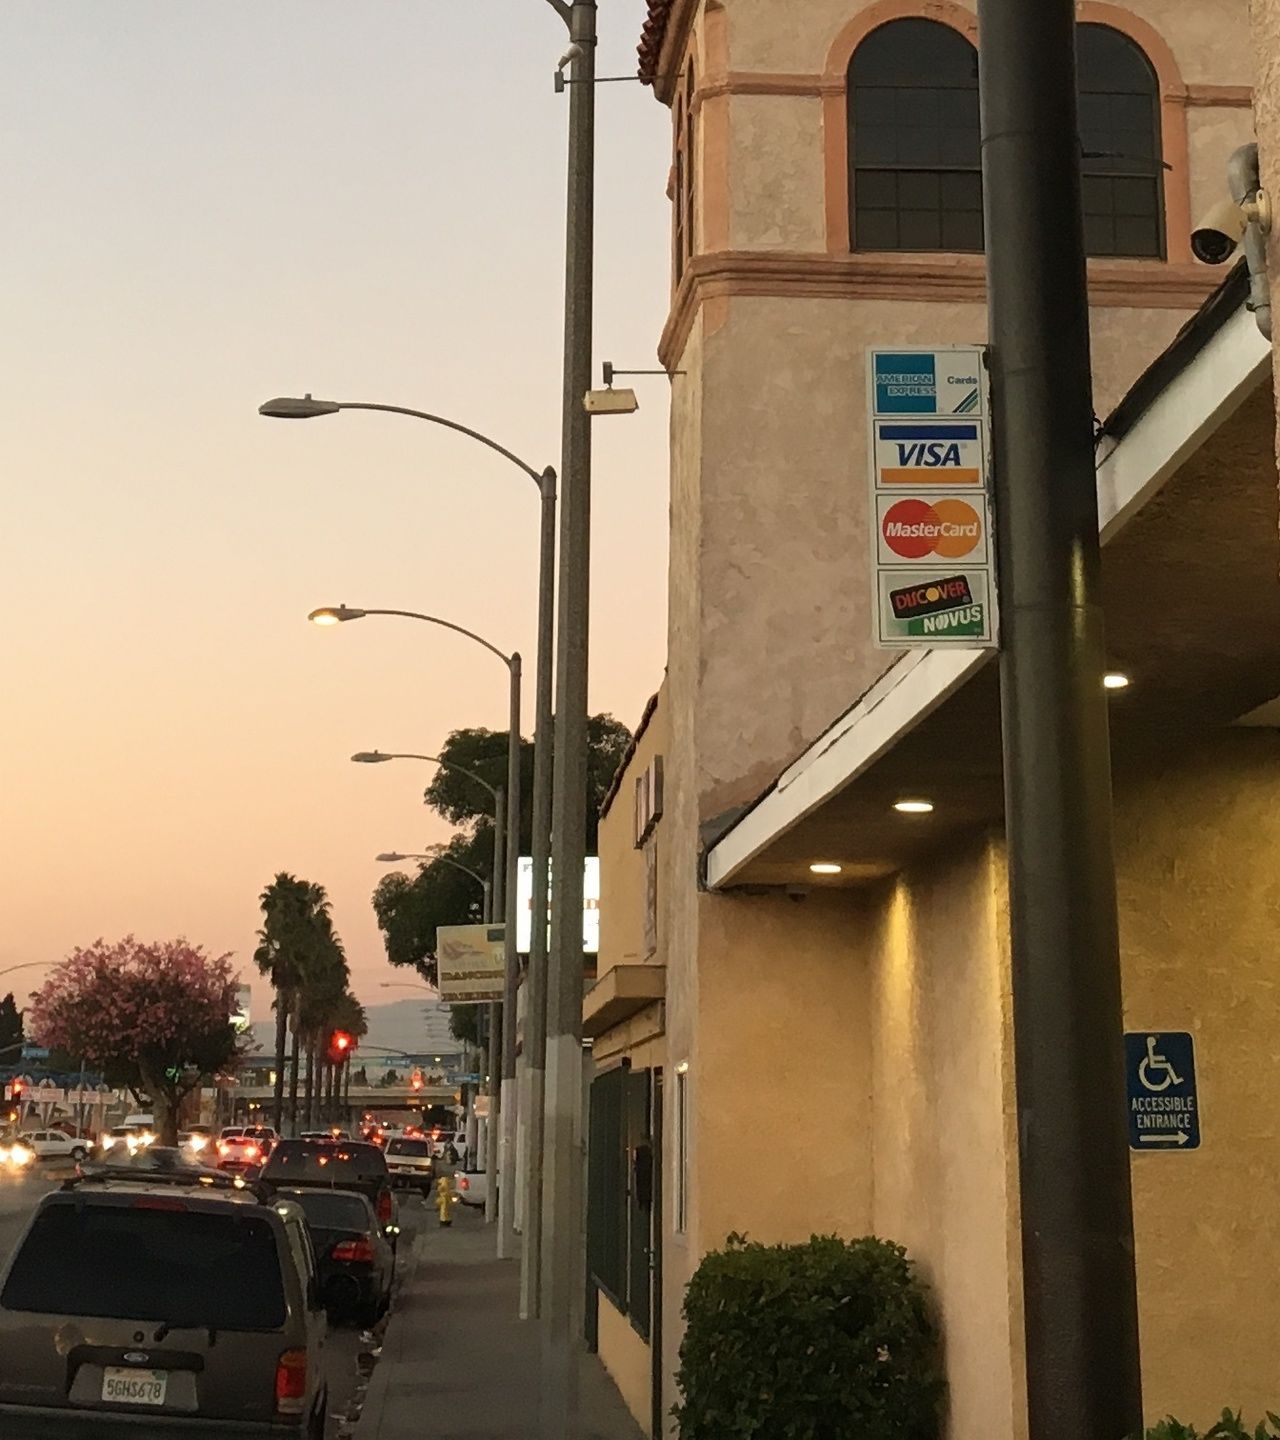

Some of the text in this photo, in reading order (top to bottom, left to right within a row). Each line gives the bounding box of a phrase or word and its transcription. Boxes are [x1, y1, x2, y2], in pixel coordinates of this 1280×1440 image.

[876, 373, 933, 385] AMERICAN
[947, 375, 978, 385] Cards
[888, 385, 937, 397] EXPRESS
[895, 442, 962, 467] VISA
[886, 522, 979, 538] MasterCard
[895, 580, 968, 610] DISCOVER
[923, 606, 981, 634] NOVUS
[1131, 1096, 1195, 1112] ACCESSIBLE
[1136, 1113, 1192, 1129] ENTRANCE
